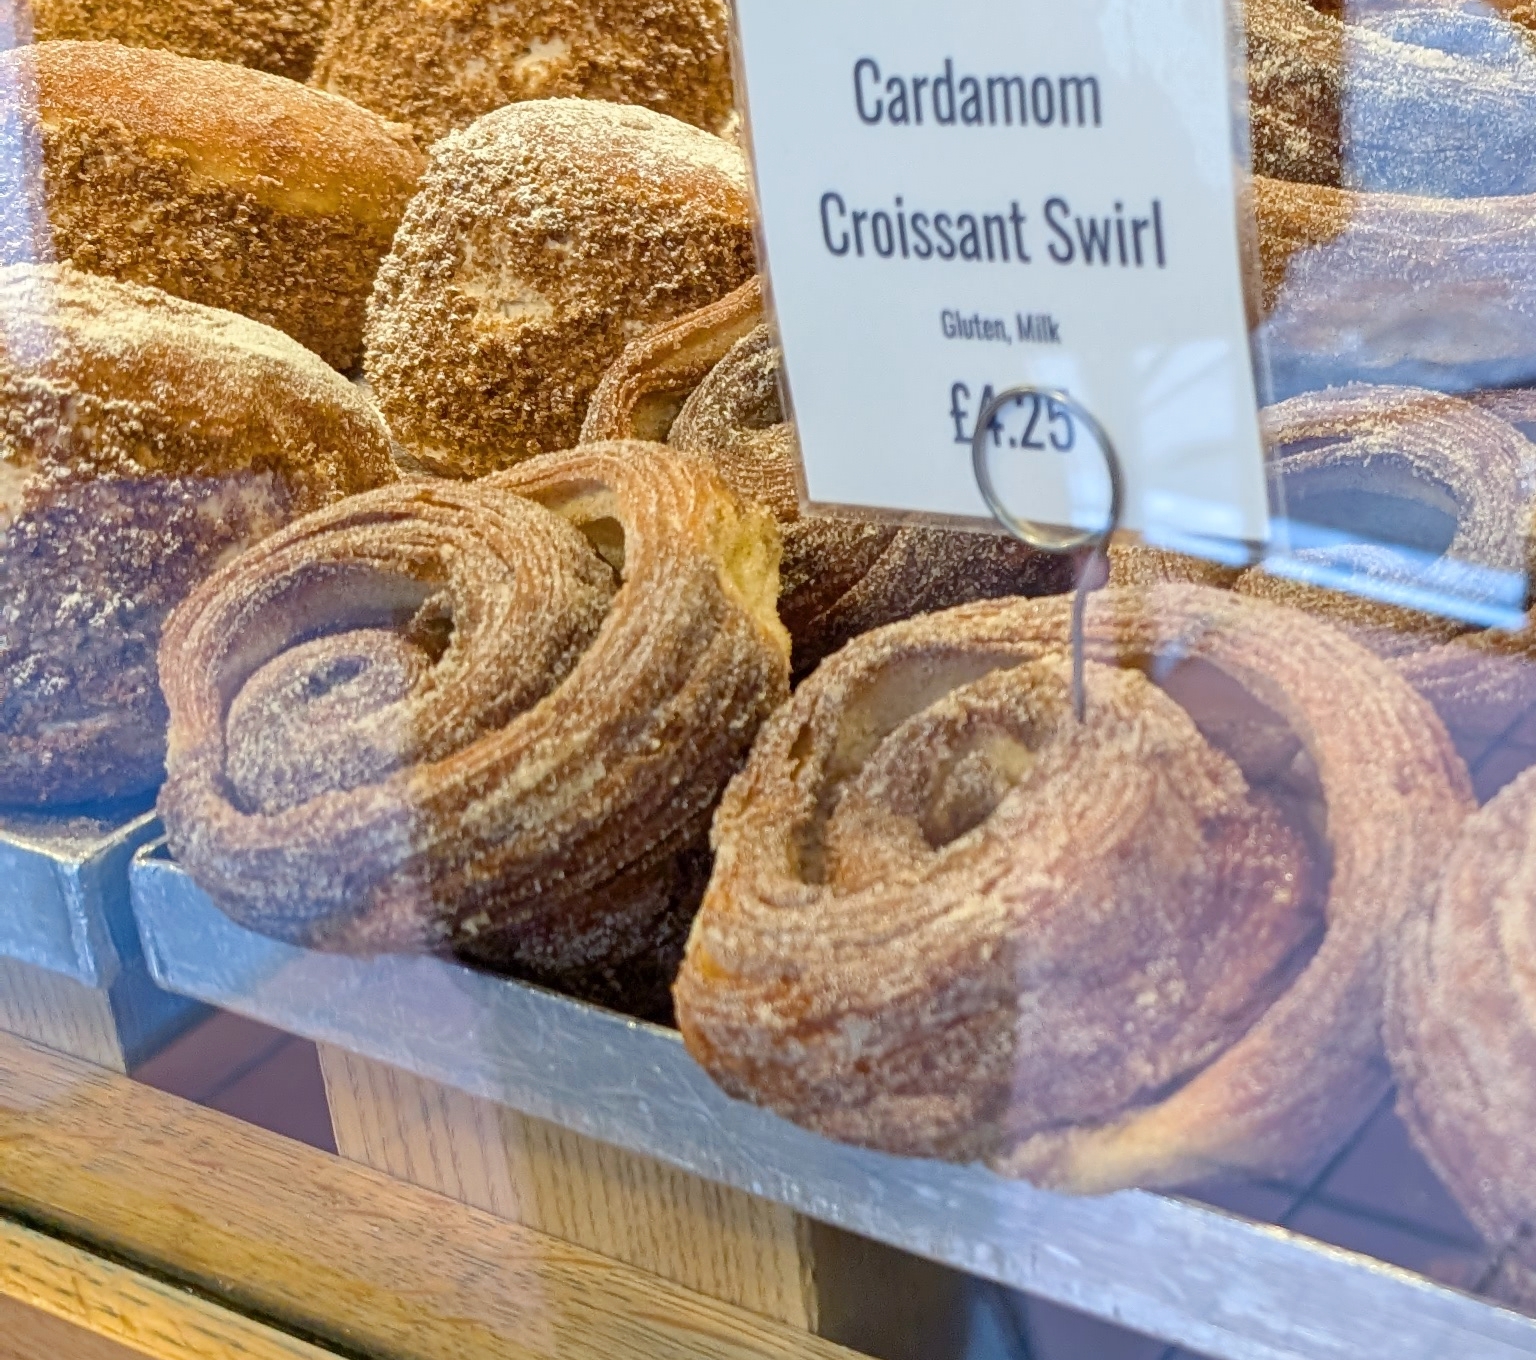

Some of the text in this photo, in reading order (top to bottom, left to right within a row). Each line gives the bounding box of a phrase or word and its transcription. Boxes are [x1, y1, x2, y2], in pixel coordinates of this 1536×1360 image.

[853, 58, 1103, 127] Cardamom
[819, 191, 1166, 269] Croissant Swirl
[941, 309, 1062, 345] Gluten, Milk
[950, 382, 1075, 452] £4.25
